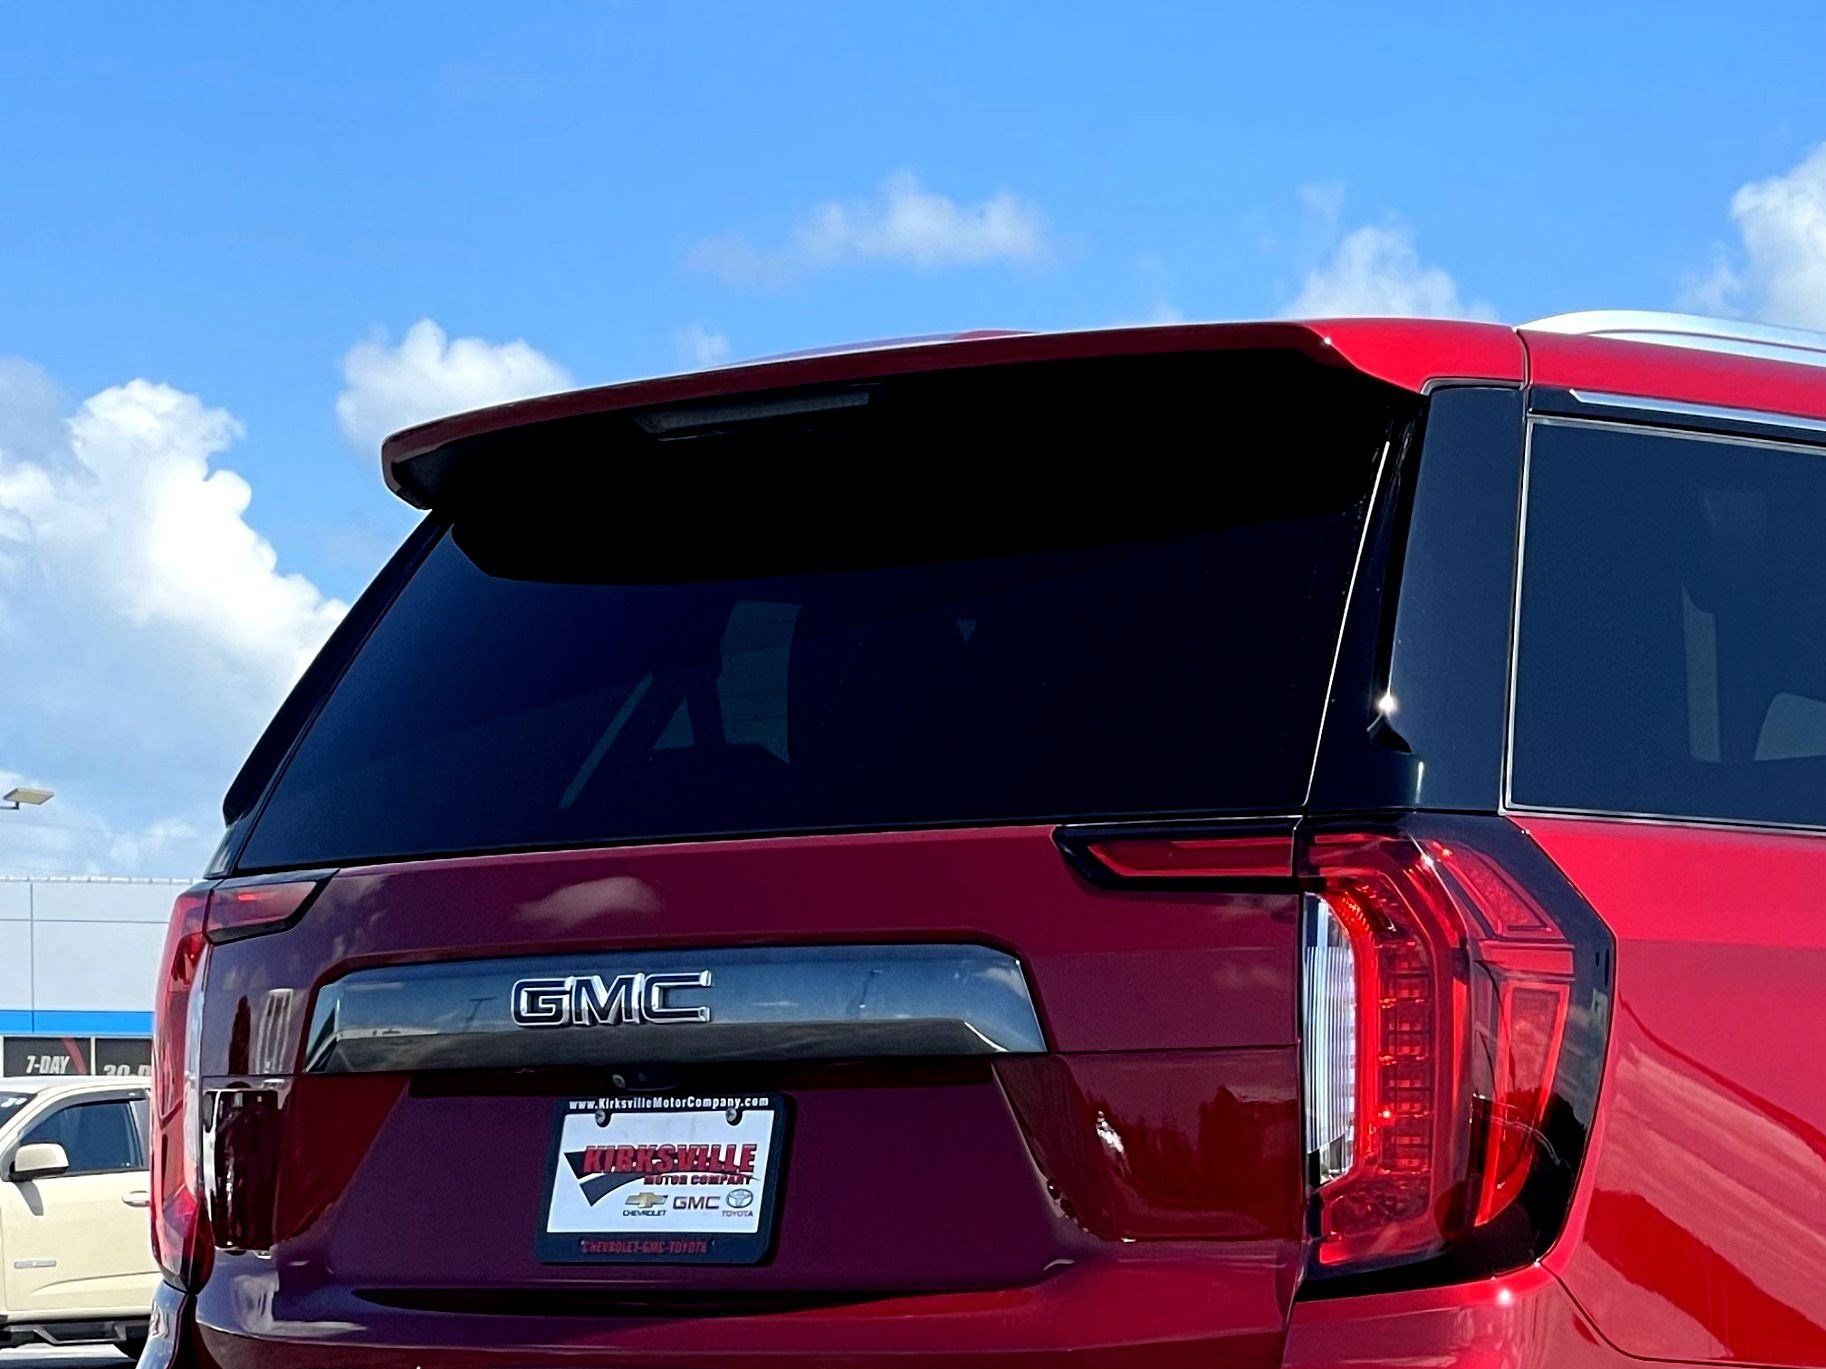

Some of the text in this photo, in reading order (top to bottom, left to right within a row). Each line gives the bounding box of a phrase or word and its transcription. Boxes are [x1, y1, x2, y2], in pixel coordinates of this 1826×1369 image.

[511, 970, 712, 1026] GMC
[26, 1055, 70, 1075] 7-DAY
[569, 1096, 769, 1110] www.KirksvilleMotorCompany.com
[583, 1143, 758, 1174] KIRKSVILLE
[644, 1175, 753, 1185] MOTOR COMPANY
[672, 1196, 721, 1210] GMC
